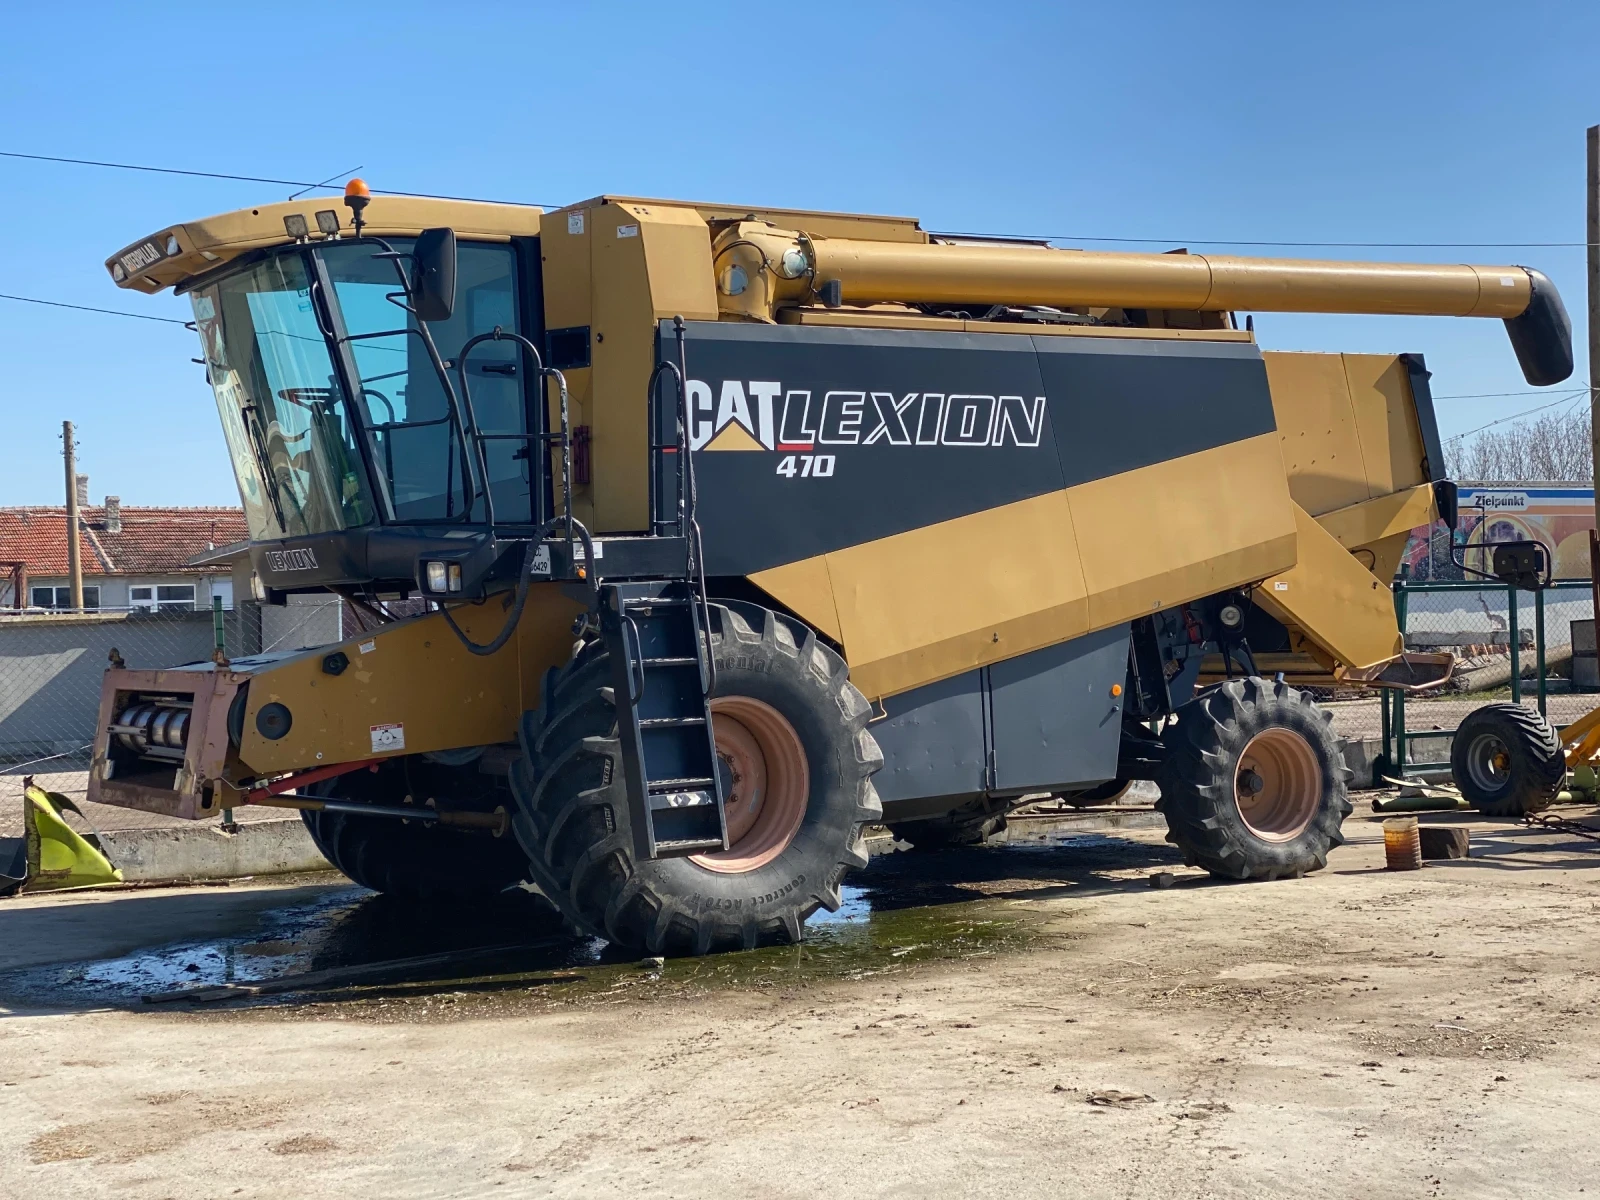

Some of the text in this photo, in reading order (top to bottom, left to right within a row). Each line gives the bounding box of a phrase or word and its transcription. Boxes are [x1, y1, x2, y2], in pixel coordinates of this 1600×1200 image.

[120, 243, 160, 272] CATERPILLAR
[683, 379, 1047, 451] CAT LEXION
[776, 455, 836, 478] 470
[1475, 496, 1524, 508] Zielpunkt
[265, 548, 319, 571] LEXION
